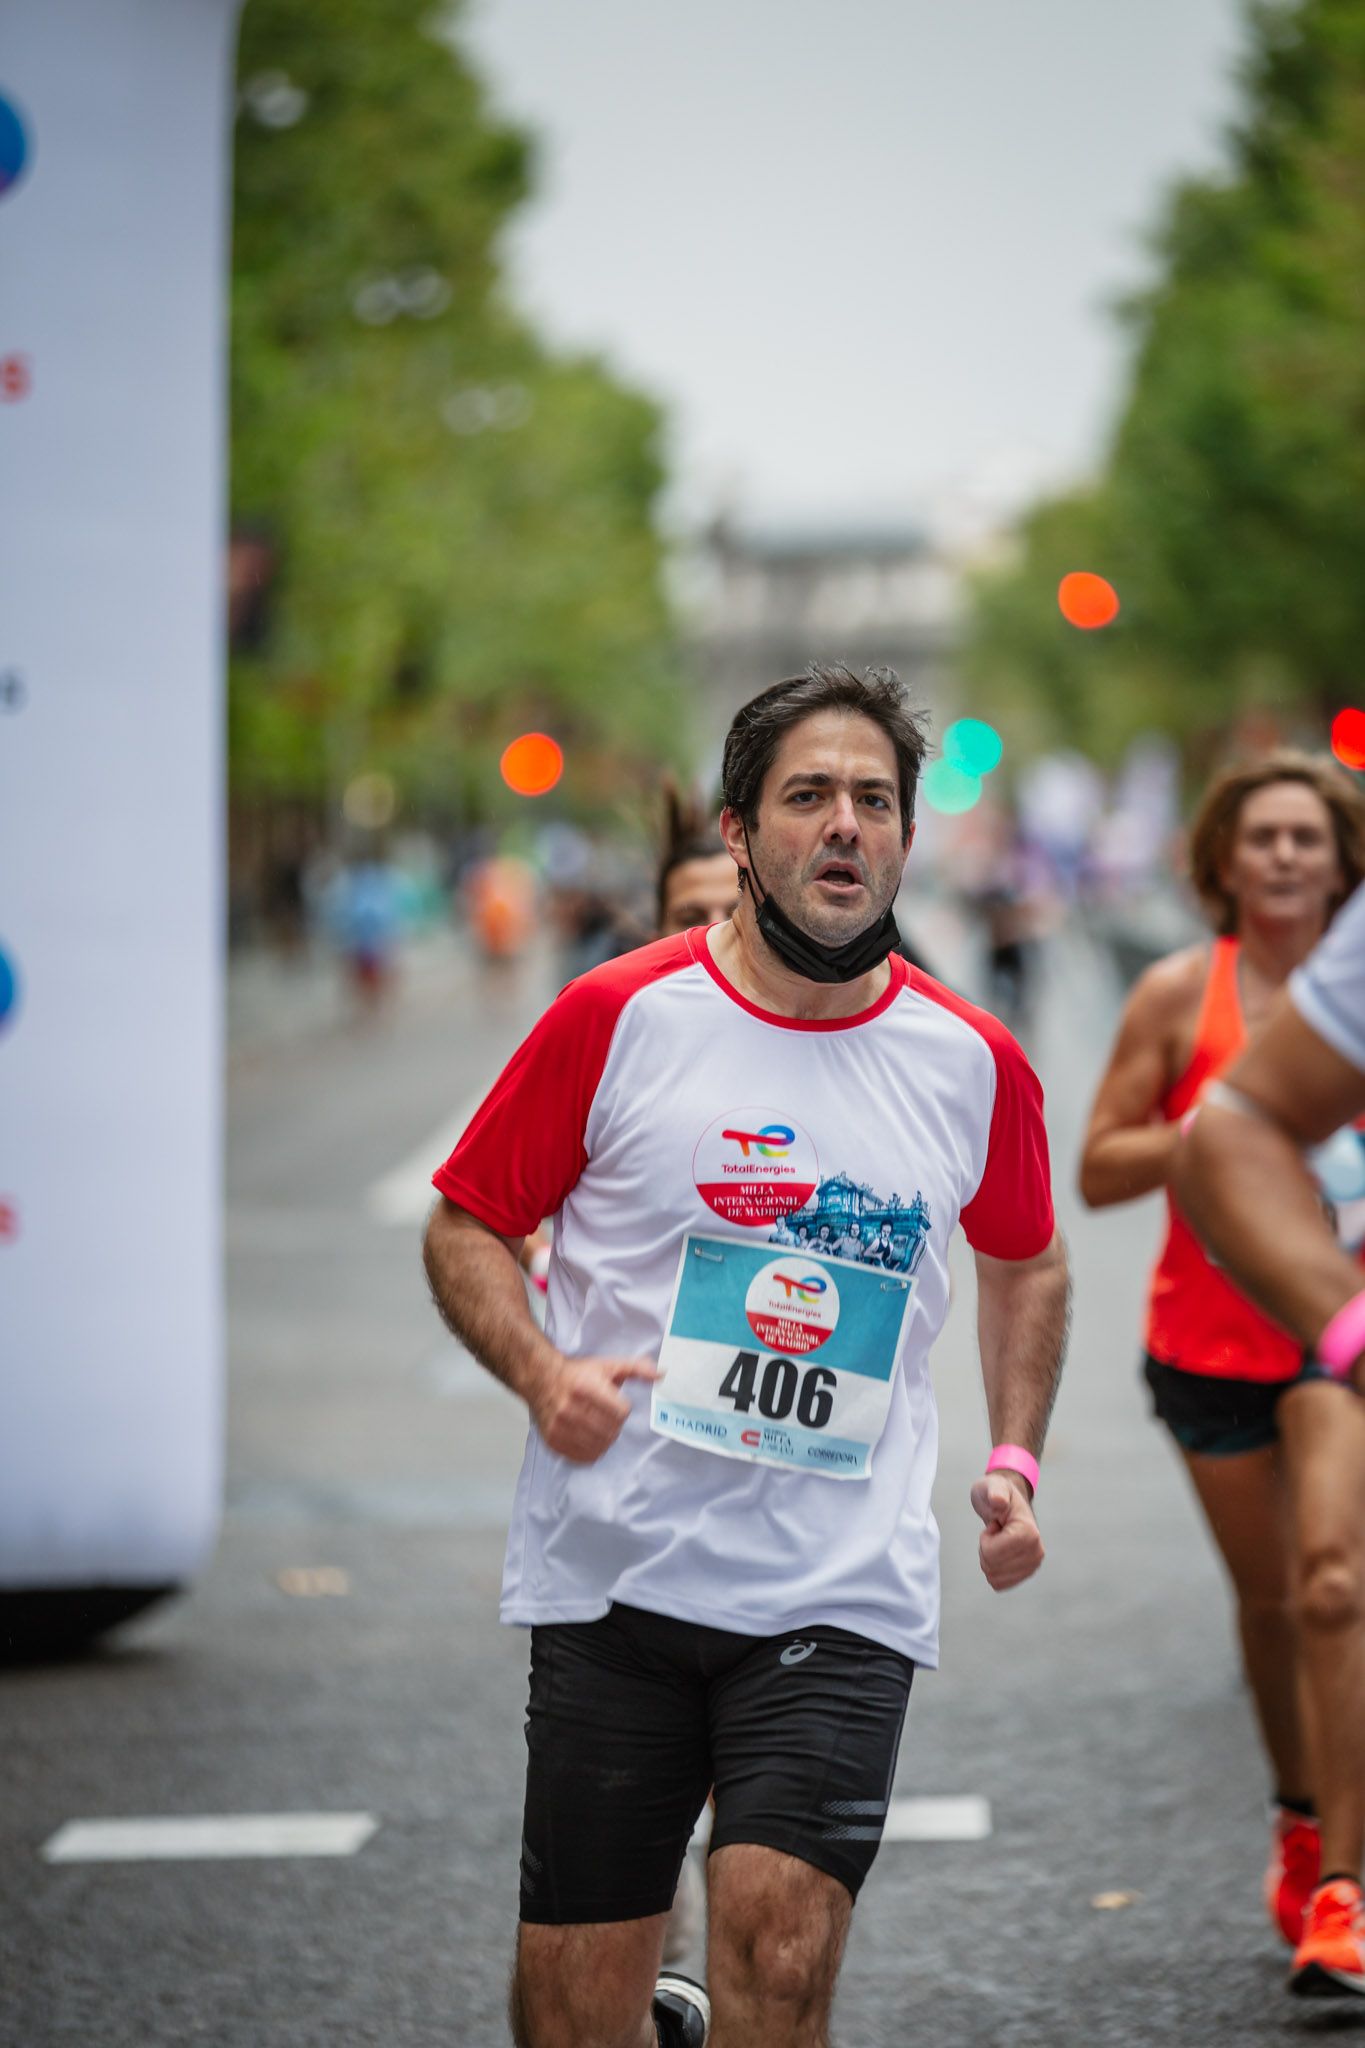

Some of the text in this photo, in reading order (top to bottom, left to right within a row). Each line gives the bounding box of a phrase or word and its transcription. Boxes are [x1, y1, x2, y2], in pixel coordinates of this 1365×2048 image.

[722, 1164, 796, 1175] TotalEnergies
[740, 1185, 775, 1196] MILLA
[713, 1195, 801, 1208] INTERNACIONAL
[727, 1206, 788, 1218] DE MADRID
[768, 1299, 822, 1319] TotalEnergies
[778, 1318, 803, 1333] MILLA
[764, 1333, 810, 1352] DE MADRID
[718, 1350, 838, 1429] 406
[675, 1418, 727, 1438] MADRID
